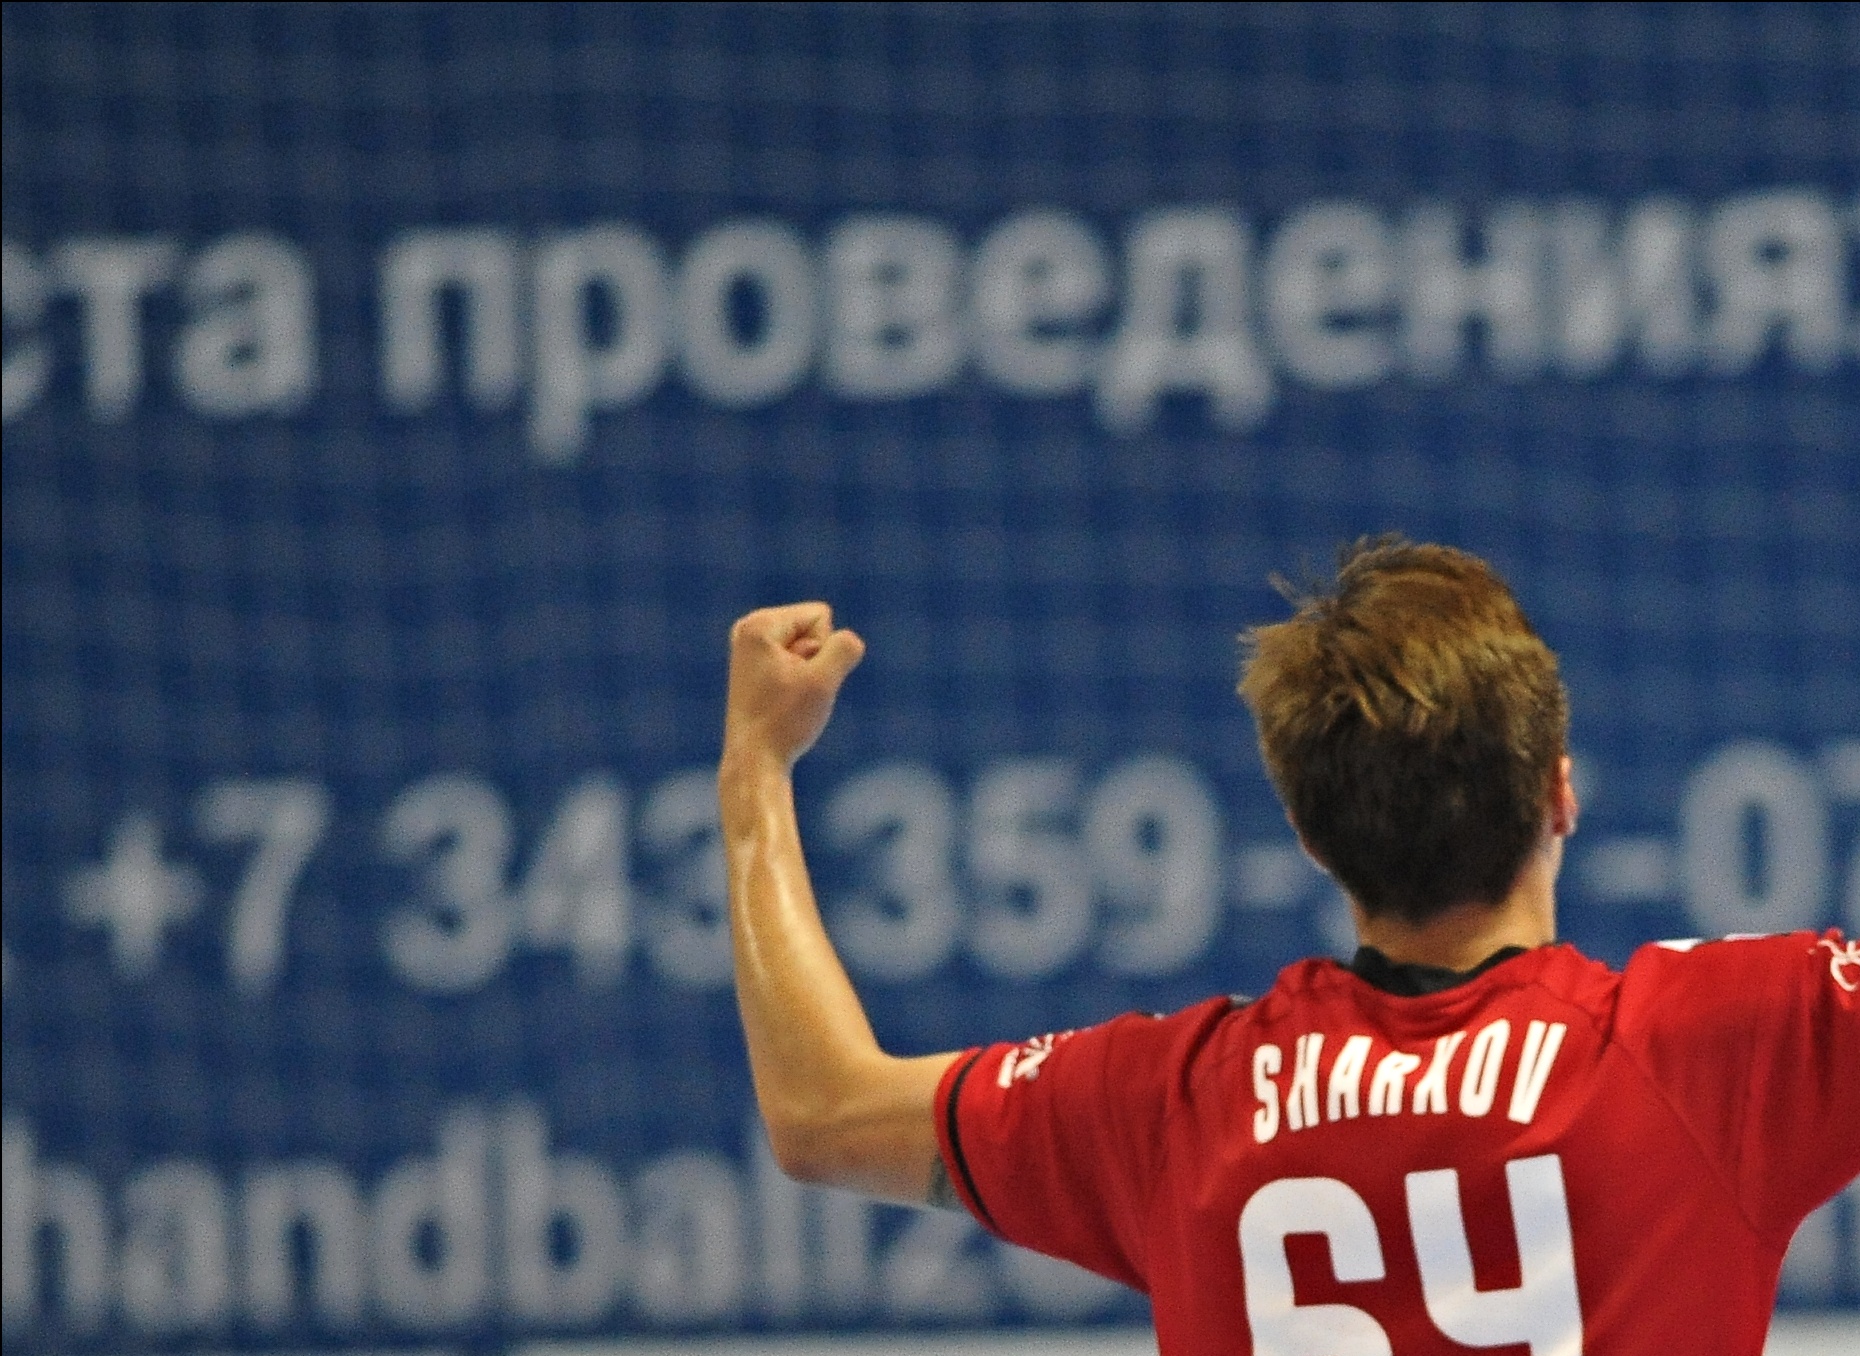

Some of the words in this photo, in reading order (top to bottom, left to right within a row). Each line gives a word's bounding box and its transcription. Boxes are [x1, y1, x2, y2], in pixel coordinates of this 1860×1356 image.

[60, 776, 333, 997] +7
[385, 768, 738, 992] 343
[1252, 1018, 1567, 1144] SHARKOV
